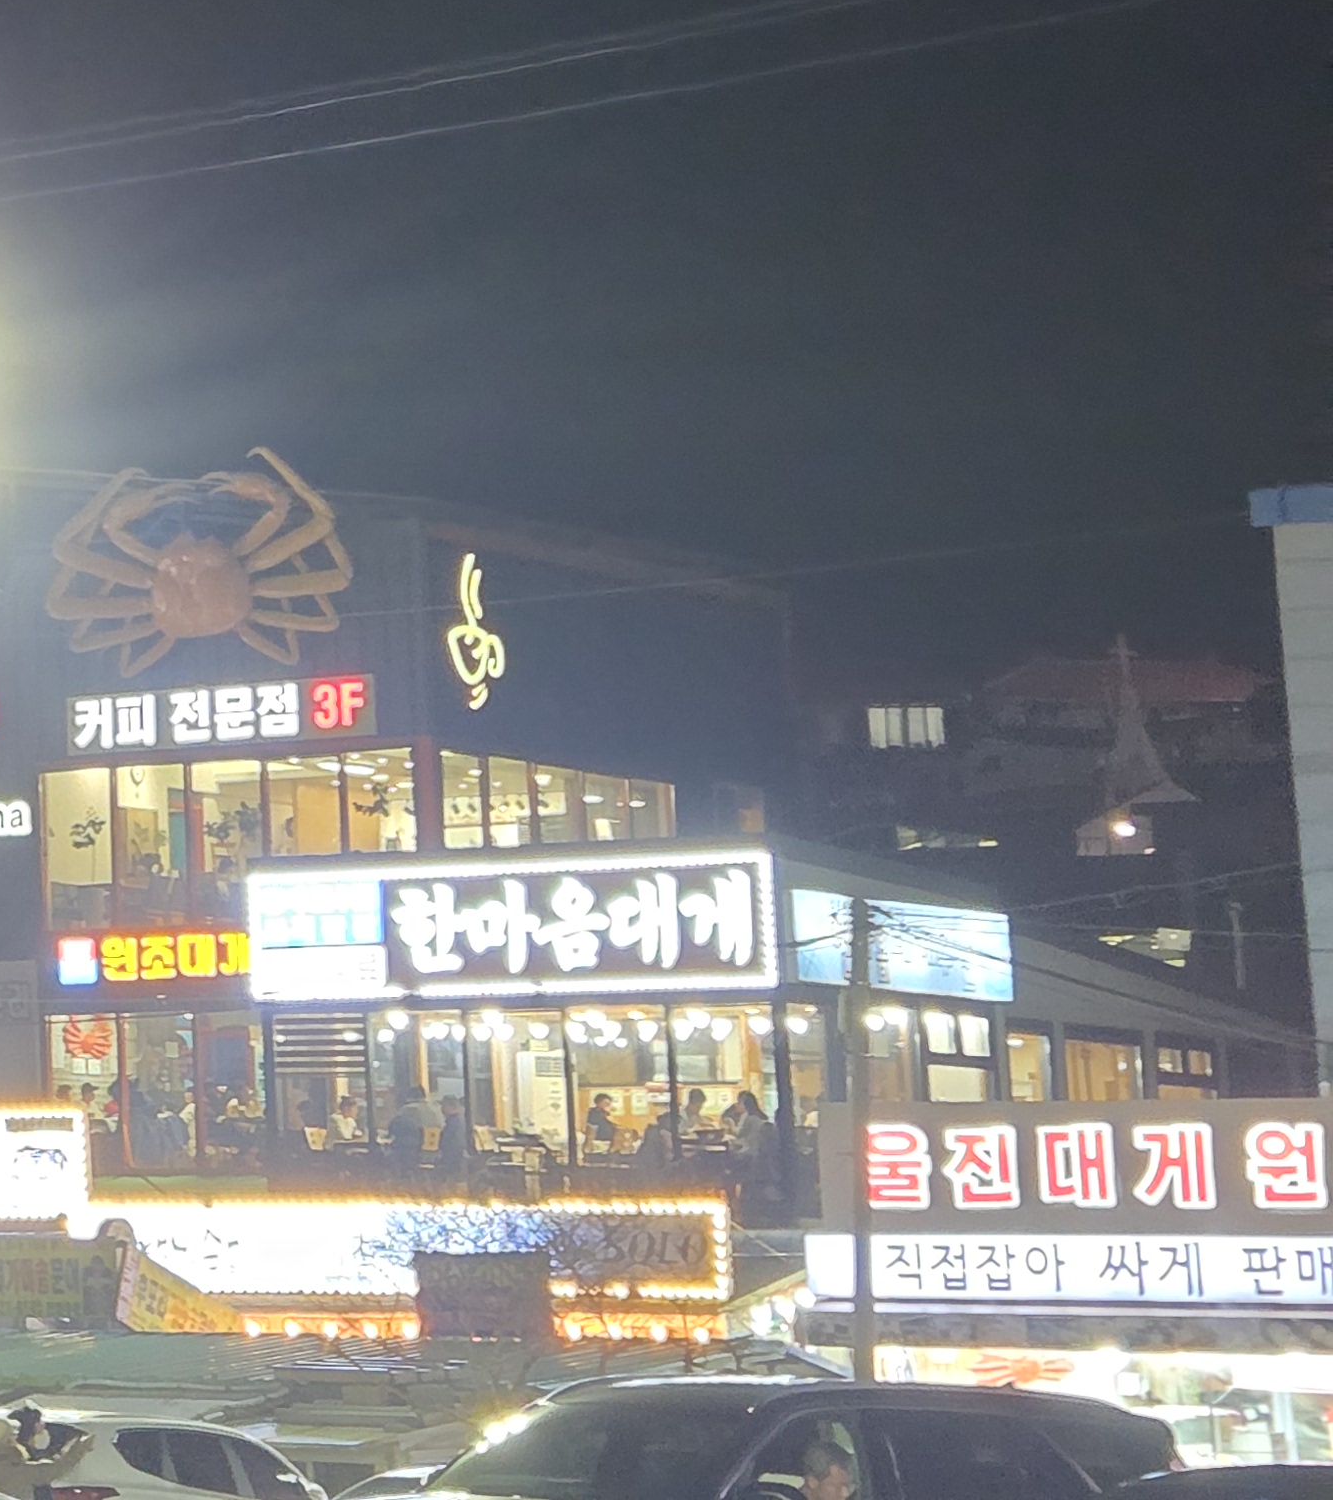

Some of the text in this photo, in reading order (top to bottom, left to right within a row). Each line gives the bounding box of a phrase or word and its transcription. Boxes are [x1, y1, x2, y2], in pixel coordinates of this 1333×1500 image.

[74, 681, 364, 749] 커피 전문점 3F
[390, 869, 753, 974] 한마음대게
[886, 1243, 1065, 1292] 직접잡아
[1099, 1241, 1204, 1297] 싸게
